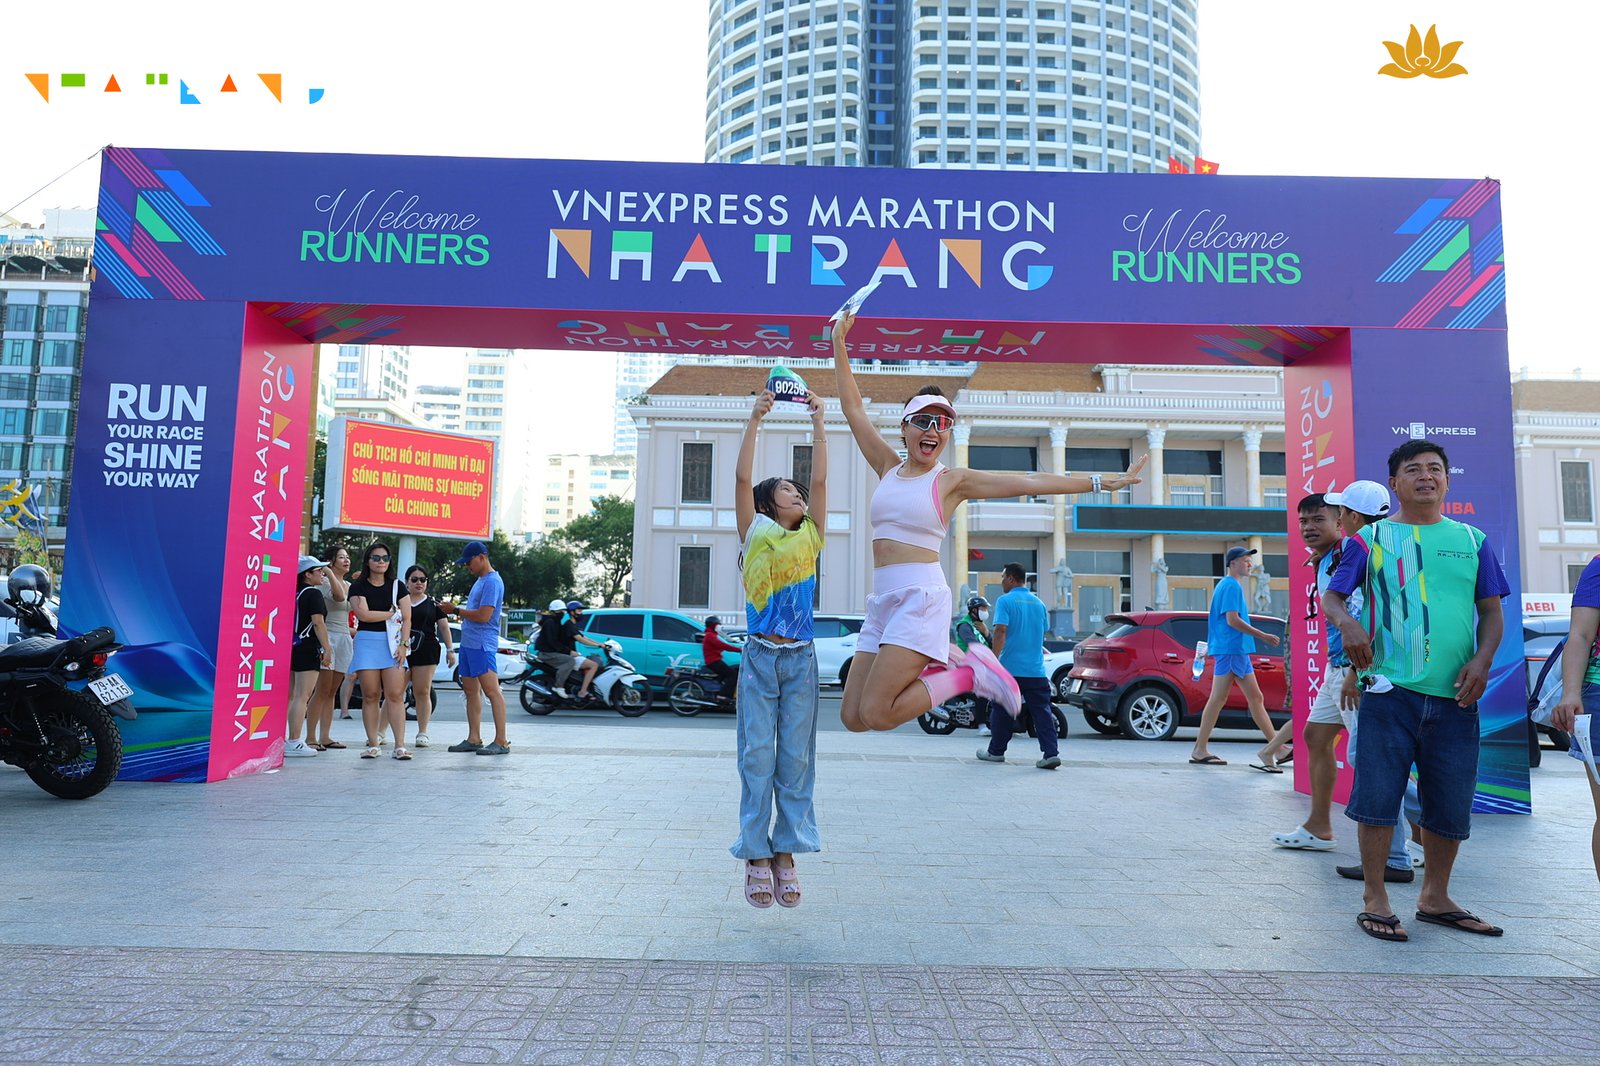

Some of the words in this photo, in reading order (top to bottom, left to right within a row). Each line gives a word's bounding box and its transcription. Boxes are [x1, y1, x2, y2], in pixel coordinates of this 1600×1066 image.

[315, 189, 480, 237] Welcome
[552, 189, 789, 226] VNEXPRESS
[808, 195, 1055, 234] MARATHON
[300, 230, 490, 266] RUNNERS
[1122, 208, 1290, 257] Welcome
[547, 228, 722, 283] NHA
[754, 234, 1054, 291] TRANG
[1112, 250, 1302, 285] RUNNERS
[107, 383, 207, 421] RUN
[107, 424, 153, 439] YOUR
[156, 425, 204, 440] RACE
[1391, 422, 1477, 440] VNEXPRESS
[103, 442, 202, 470] SHINE
[262, 364, 295, 582] TRANG
[353, 439, 373, 459] CHỦ
[375, 445, 397, 464] TỊCH
[415, 449, 431, 467] CHÍ
[432, 453, 457, 471] MINH
[470, 458, 485, 476] ĐẠI
[103, 471, 153, 487] YOUR
[157, 473, 200, 488] WAY
[352, 464, 379, 486] SỐNG
[382, 470, 401, 488] MÃI
[403, 473, 434, 492] TRONG
[436, 478, 450, 496] SỰ
[450, 480, 484, 500] NGHIỆP
[385, 493, 404, 514] CỦA
[407, 498, 439, 518] CHÚNG
[441, 503, 451, 519] TA
[233, 554, 260, 742] VNEXPRESS
[250, 350, 276, 541] MARATHON
[94, 676, 119, 692] 79-AA
[249, 607, 279, 740] NHA
[100, 684, 129, 703] 621.15
